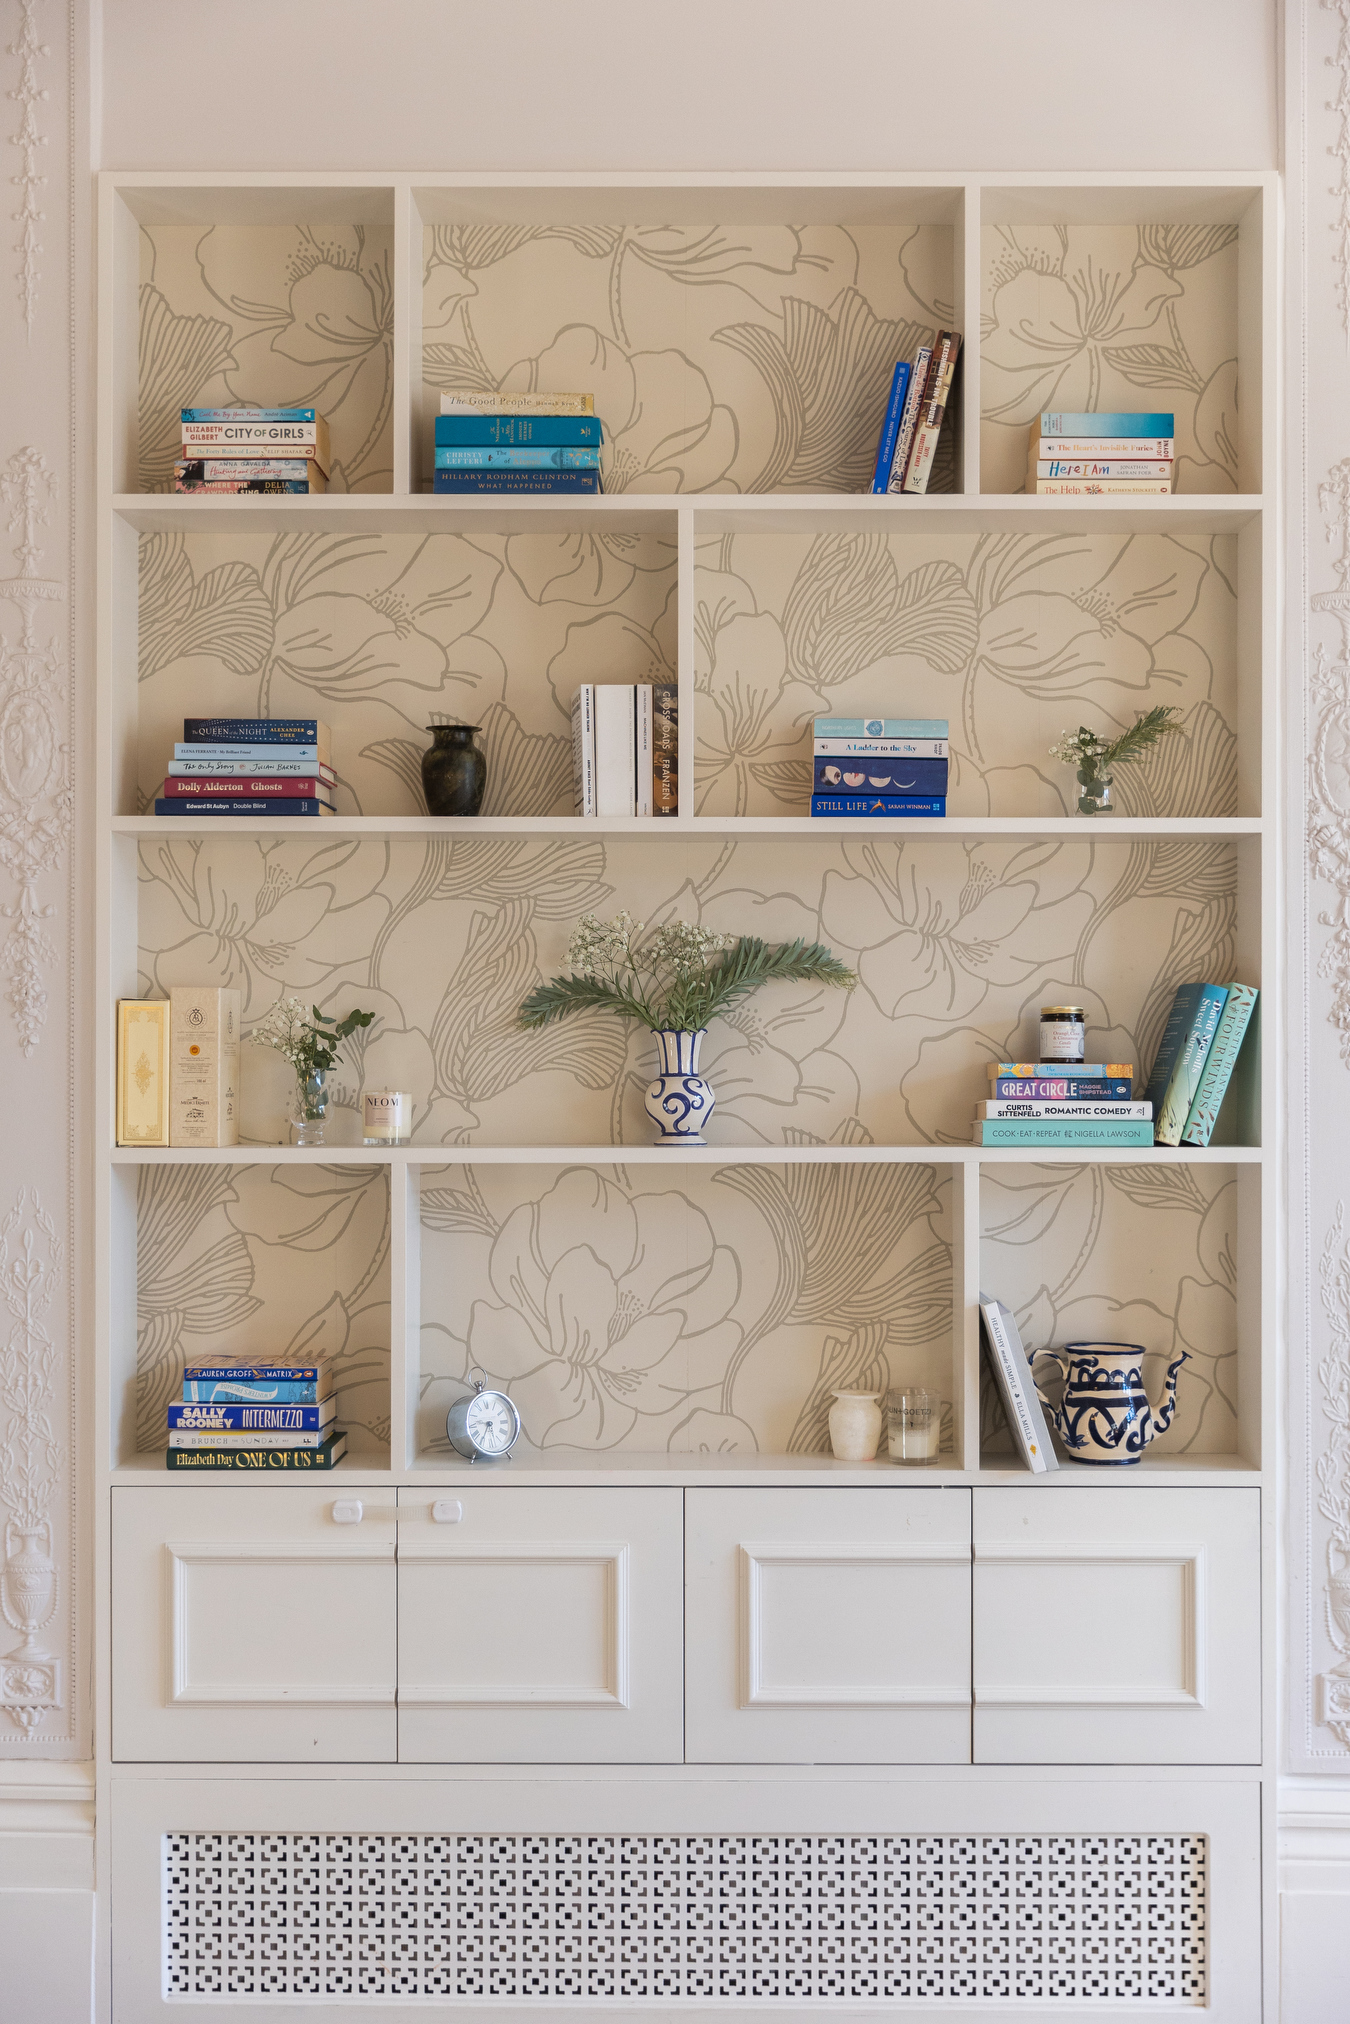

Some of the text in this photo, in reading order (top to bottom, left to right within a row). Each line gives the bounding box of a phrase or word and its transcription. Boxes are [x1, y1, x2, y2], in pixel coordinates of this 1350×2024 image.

[927, 341, 951, 426] FLEISHMAN IS IN TROUBLE
[468, 397, 496, 405] Good
[500, 397, 532, 407] People
[911, 389, 920, 410] Botton
[224, 428, 304, 439] CITY OF GIRLS
[513, 458, 542, 466] Aleppo
[883, 454, 888, 462] GO
[210, 466, 237, 479] Hunting
[250, 466, 282, 476] Gathering
[1049, 461, 1110, 476] Here I Am
[1060, 486, 1081, 494] Help
[199, 727, 229, 736] QUEEN
[903, 745, 917, 753] Sky
[216, 762, 234, 774] Story
[662, 760, 670, 800] FRANZEN
[178, 782, 243, 792] Dolly Alderton
[251, 782, 282, 791] Ghosts
[816, 802, 867, 810] STILL LIFE
[1182, 998, 1210, 1065] Sweet Sorrow
[1192, 1000, 1222, 1074] David Nicholls
[1200, 1014, 1236, 1109] FOUR WINDS
[1211, 1008, 1248, 1112] KRISTIN HANNAH
[1002, 1083, 1077, 1096] GREAT CIRCLE
[367, 1098, 398, 1106] NEOM
[991, 1317, 1005, 1348] HEALTHY
[1005, 1365, 1018, 1390] SIMPLE
[221, 1384, 243, 1393] PROMISE
[183, 1408, 226, 1418] SALLY
[242, 1410, 302, 1428] INTERMEZZO
[177, 1418, 233, 1428] ROONEY
[1016, 1401, 1033, 1441] ELLA MILLS
[176, 1454, 234, 1467] Elizabeth Day
[236, 1452, 266, 1467] ONE
[269, 1452, 292, 1466] OF
[294, 1452, 311, 1467] US
